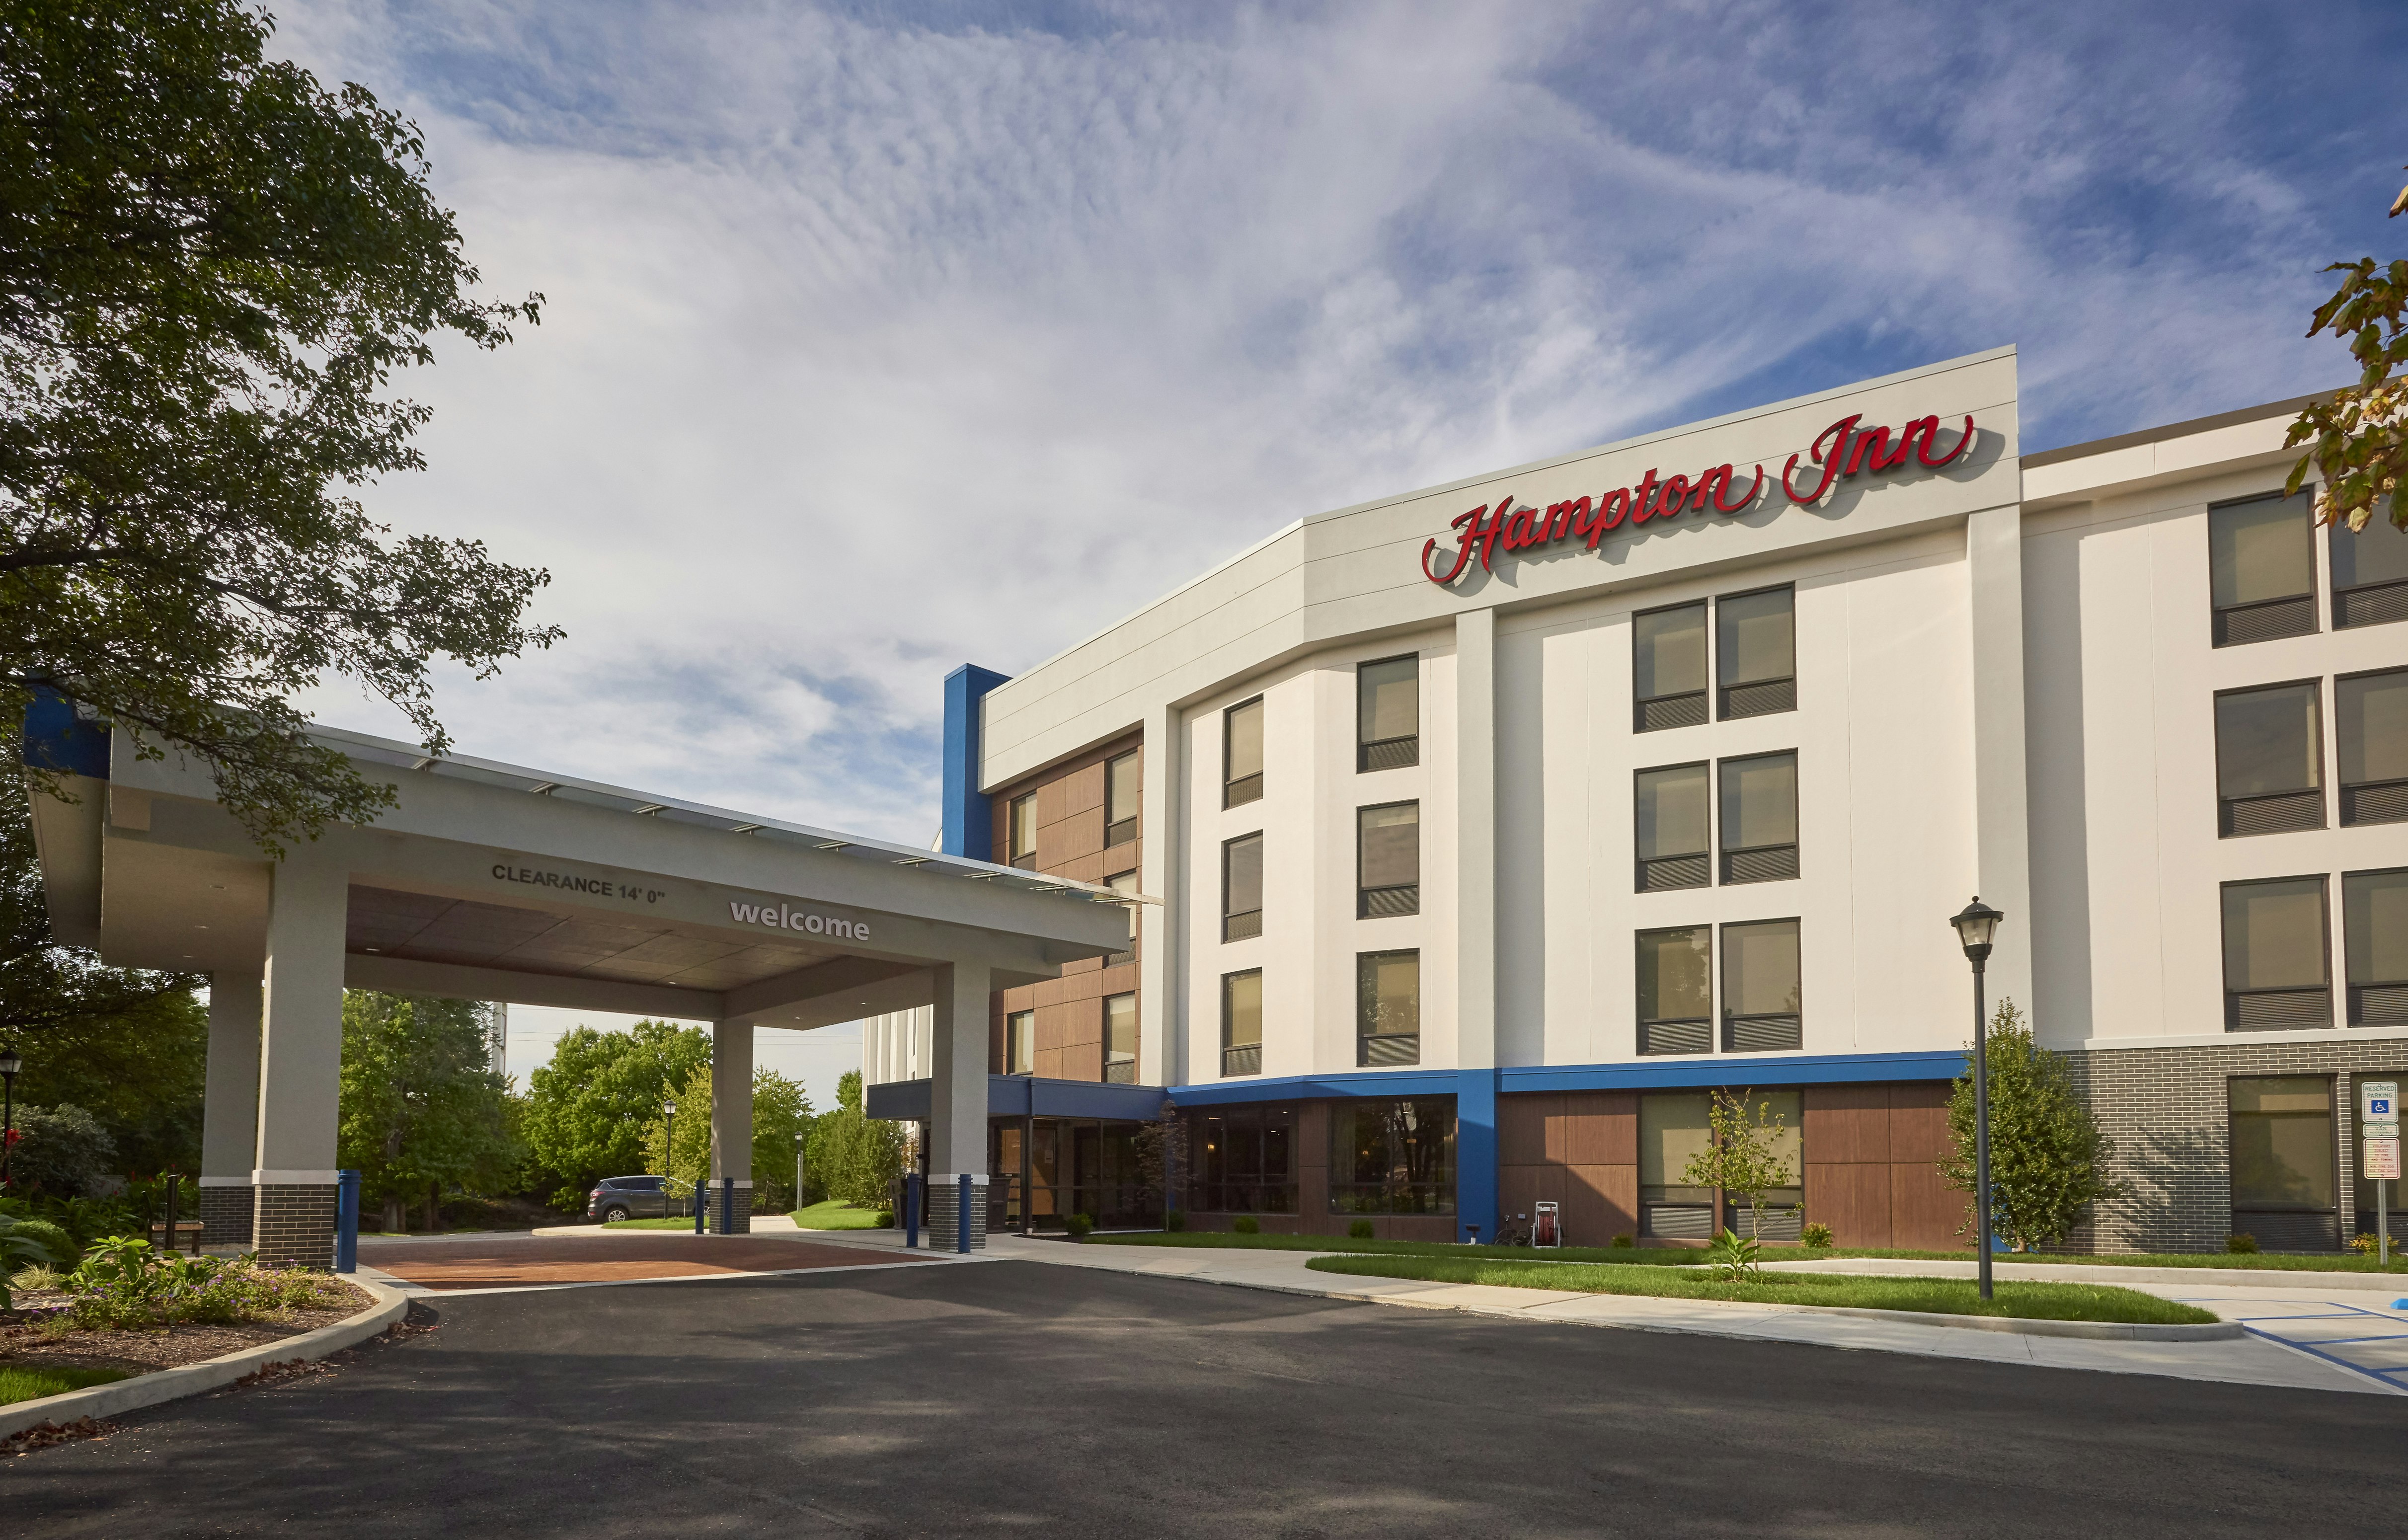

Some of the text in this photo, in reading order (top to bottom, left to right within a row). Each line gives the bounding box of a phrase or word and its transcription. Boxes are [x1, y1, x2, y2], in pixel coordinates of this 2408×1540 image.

[1421, 413, 1973, 584] Hampton Inn
[492, 864, 665, 903] CLEARANCE 14' 0"
[730, 902, 869, 940] welcome
